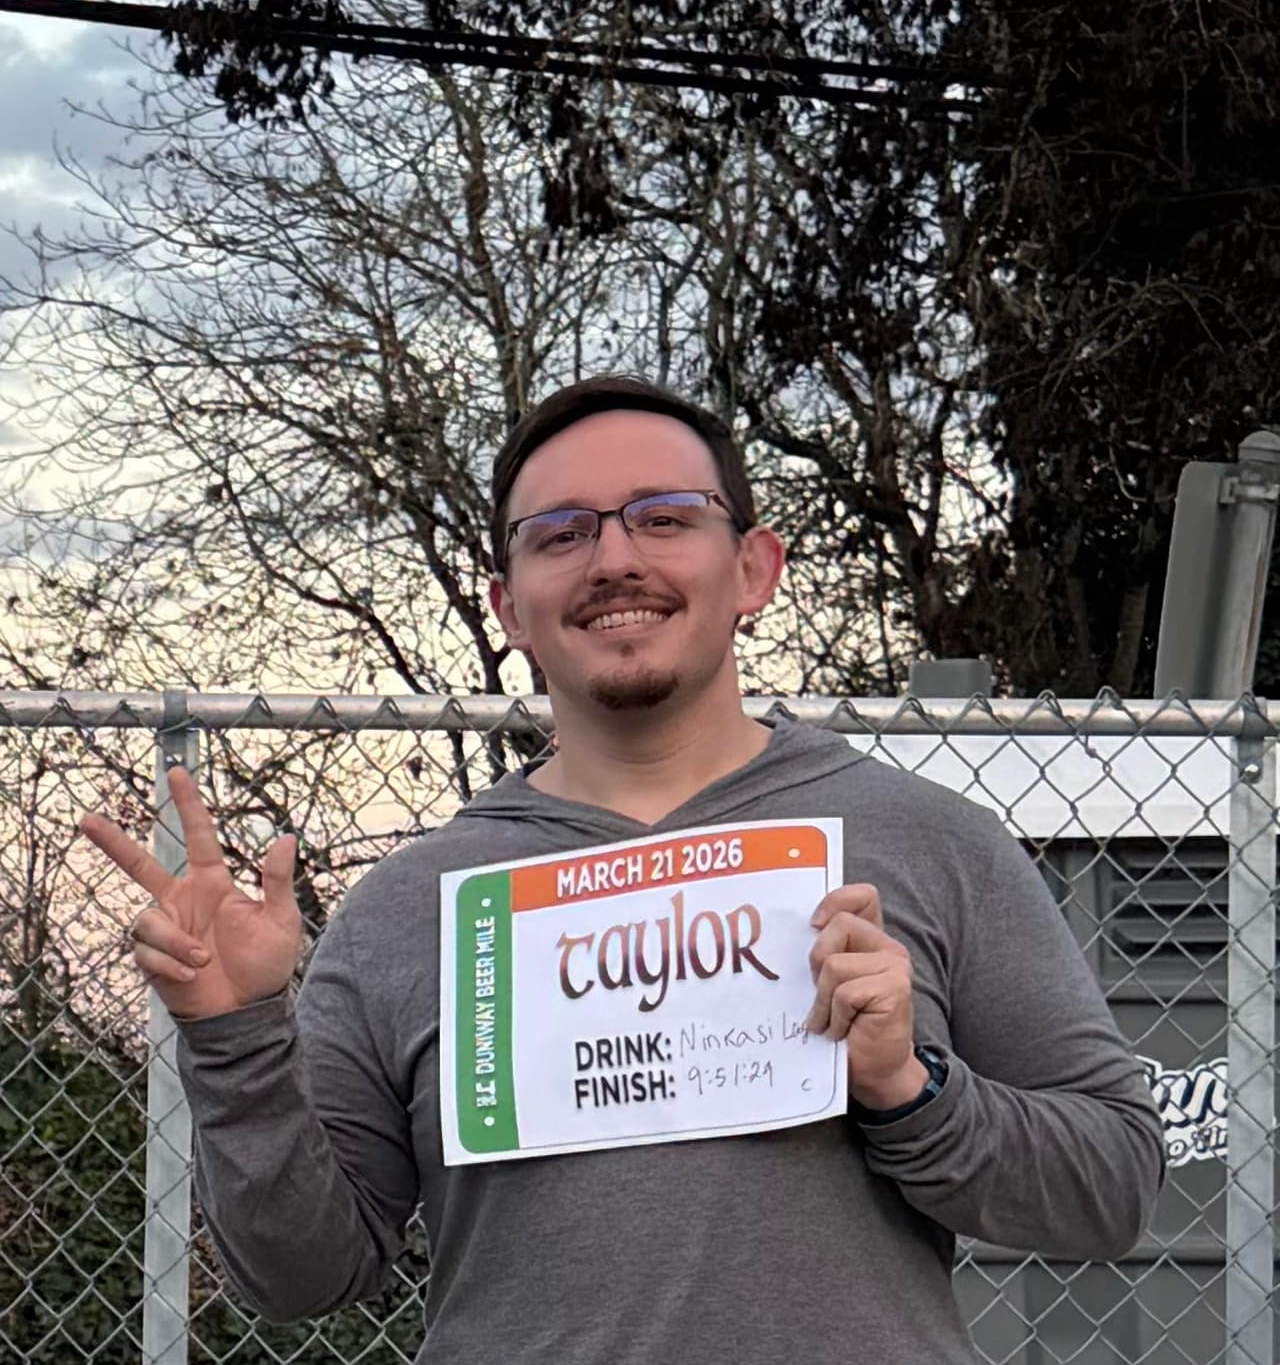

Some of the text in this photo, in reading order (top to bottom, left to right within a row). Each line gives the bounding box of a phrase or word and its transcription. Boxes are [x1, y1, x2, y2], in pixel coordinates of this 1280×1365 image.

[556, 837, 744, 899] MARCH 21 2026
[475, 916, 495, 954] MILE
[475, 956, 495, 998] BEER
[475, 1002, 495, 1075] DUNIWAY
[575, 1033, 672, 1072] DRINK:
[574, 1070, 677, 1110] FINISH:
